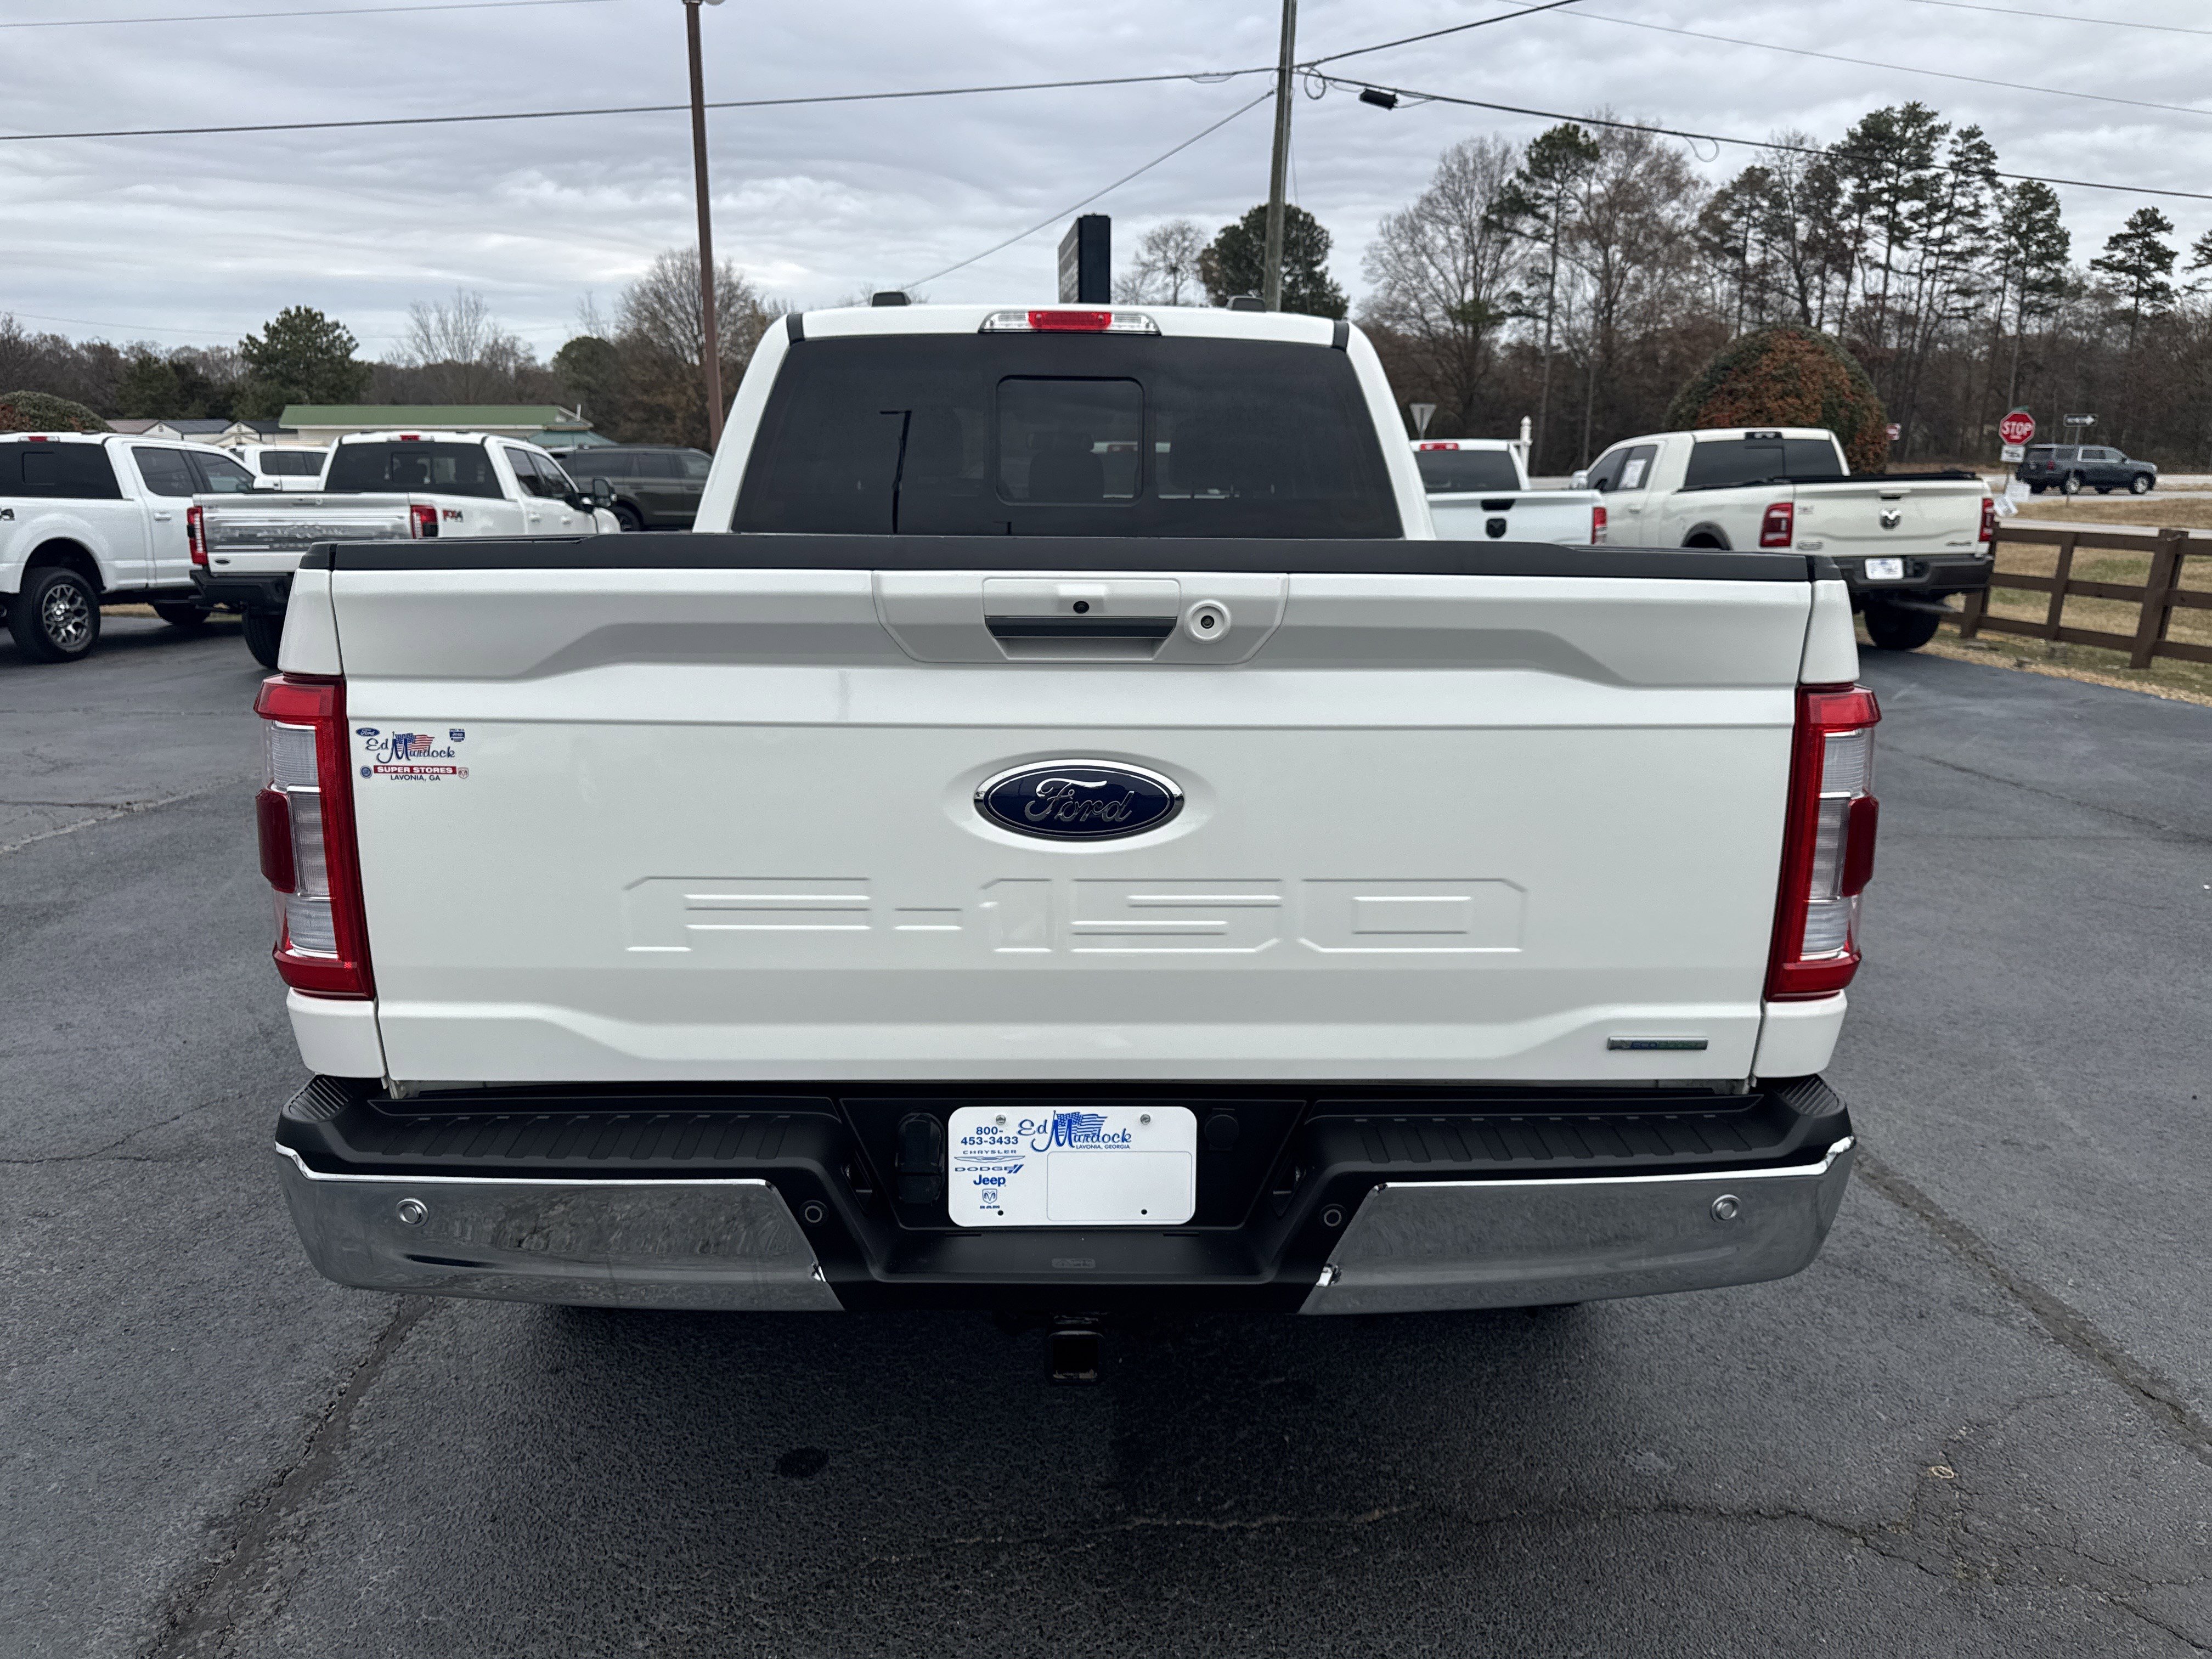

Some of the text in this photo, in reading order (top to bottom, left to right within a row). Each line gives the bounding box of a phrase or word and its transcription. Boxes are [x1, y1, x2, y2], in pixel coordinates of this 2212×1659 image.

[2001, 421, 2033, 436] STOP
[443, 510, 464, 522] FX4
[365, 731, 455, 764] Ed Murdock
[1024, 777, 1135, 822] Ford
[623, 876, 1527, 952] F-150
[976, 1126, 1003, 1135] 800-
[1017, 1110, 1132, 1152] Ed Murdock
[961, 1136, 1019, 1145] 453-3433
[973, 1174, 1006, 1187] Jeep
